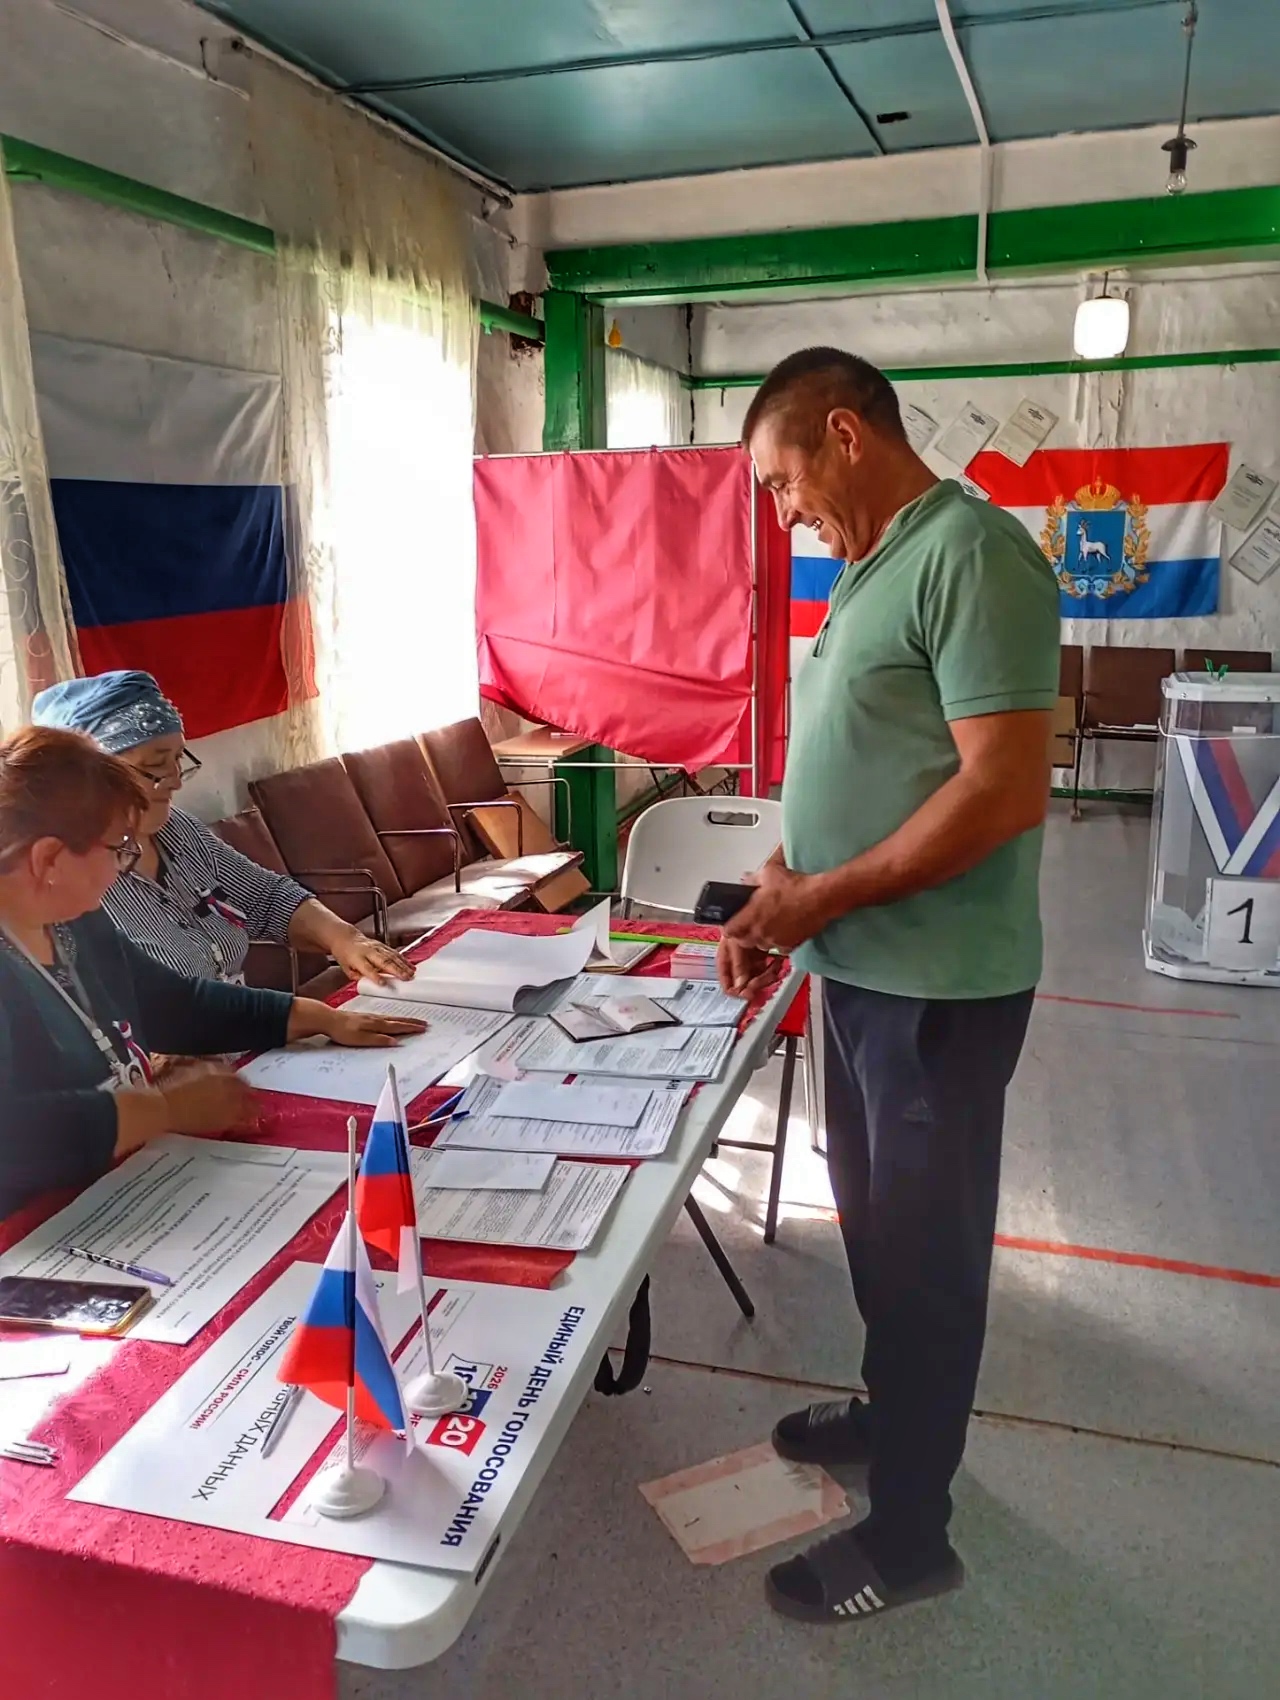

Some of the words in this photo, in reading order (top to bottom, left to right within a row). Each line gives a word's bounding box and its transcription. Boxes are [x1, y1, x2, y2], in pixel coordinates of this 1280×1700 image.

[1227, 898, 1254, 944] 1
[275, 1316, 296, 1335] ТВОЙ
[548, 1306, 585, 1364] ЕДИНЫЙ
[251, 1333, 278, 1361] ГОЛОС
[225, 1368, 249, 1394] СИЛА
[487, 1366, 508, 1389] 2026
[520, 1364, 554, 1408] ДЕНЬ
[190, 1393, 227, 1429] РОССИИ!
[440, 1417, 476, 1446] 20
[192, 1433, 258, 1501] ДАННЫХ
[440, 1410, 529, 1547] ГОЛОСОВАНИЯ
